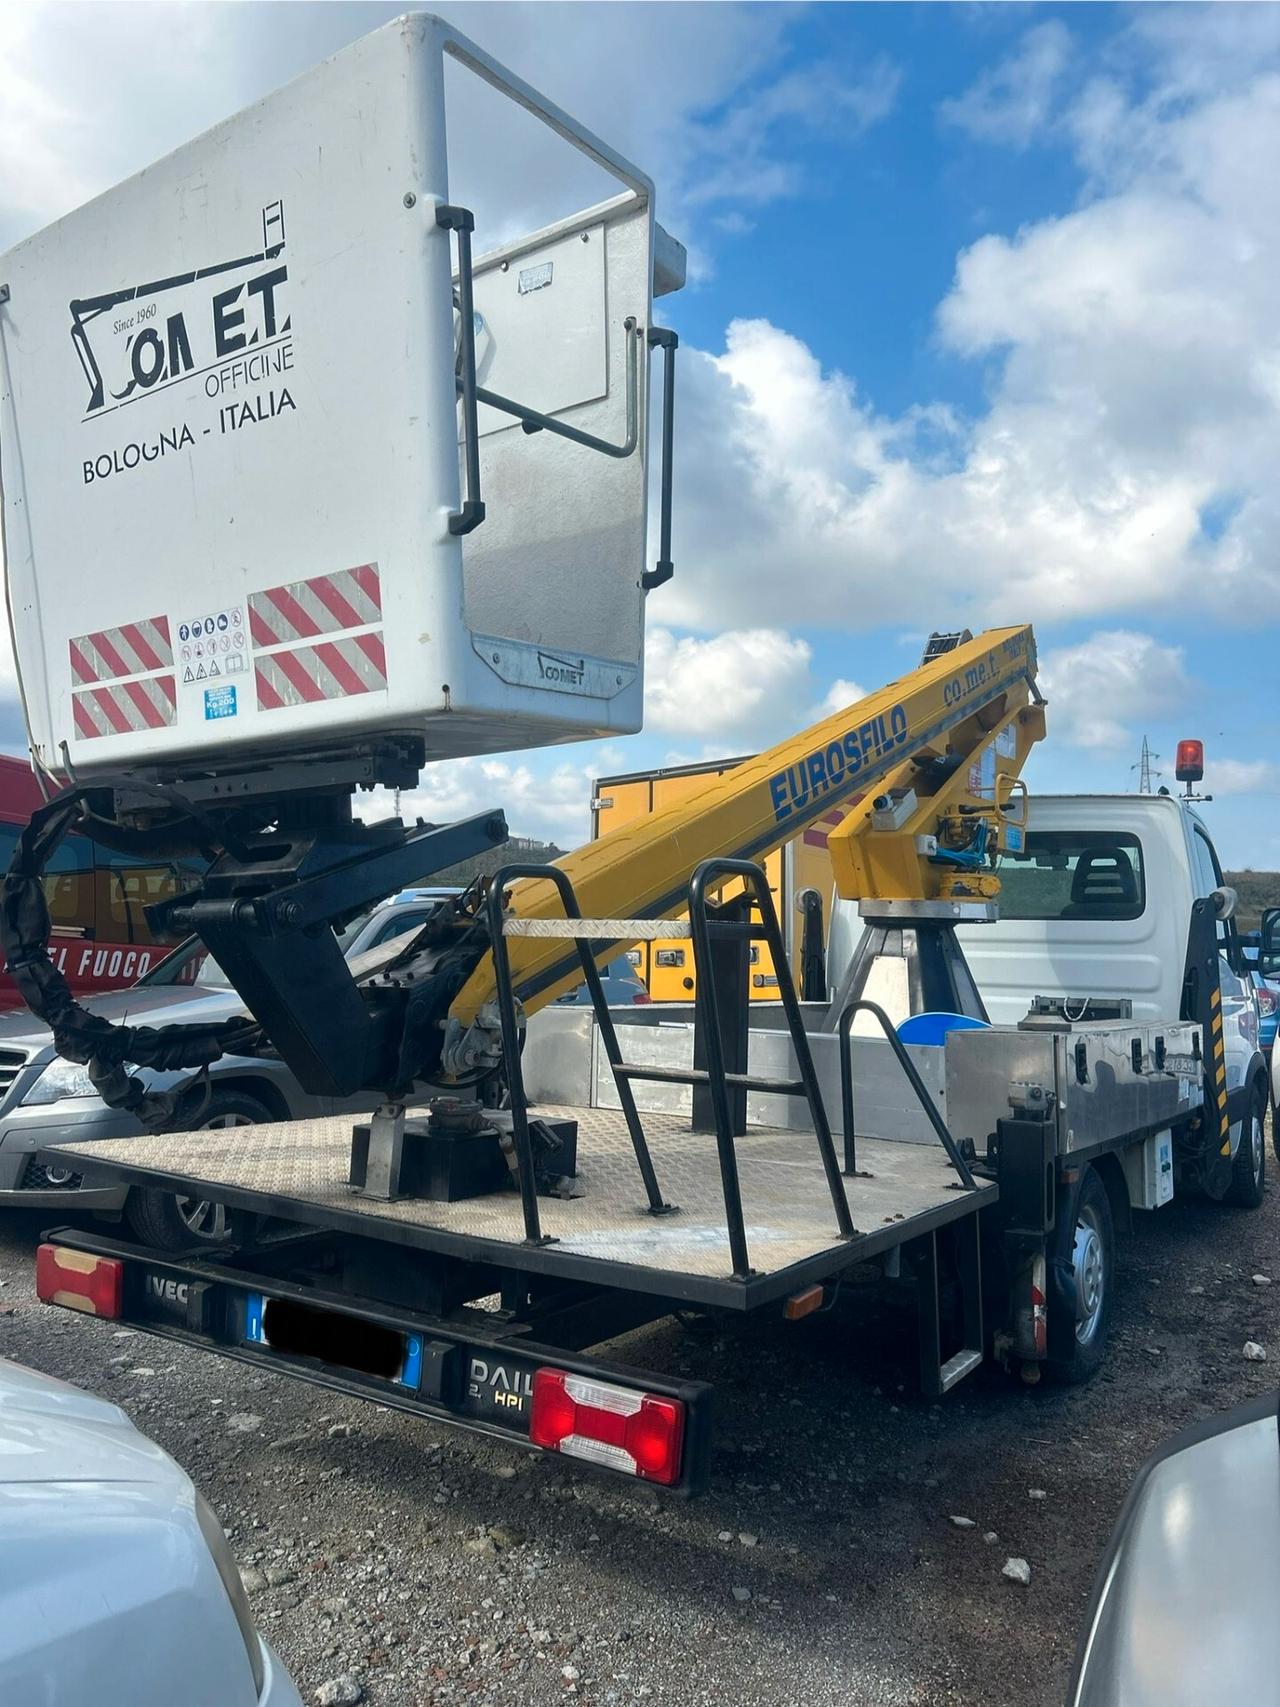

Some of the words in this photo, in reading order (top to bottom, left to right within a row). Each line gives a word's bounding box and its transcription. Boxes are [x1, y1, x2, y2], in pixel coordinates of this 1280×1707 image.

[113, 315, 135, 335] Since
[136, 303, 157, 325] 1960
[205, 343, 295, 397] OFFICINE
[82, 422, 195, 484] BOLOGNA
[220, 387, 297, 434] ITALIA
[768, 704, 907, 822] EUROSFILO
[77, 949, 151, 978] FUOCO
[146, 1274, 188, 1304] IVEC
[471, 1358, 533, 1397] DAIL
[494, 1390, 523, 1412] HPI
